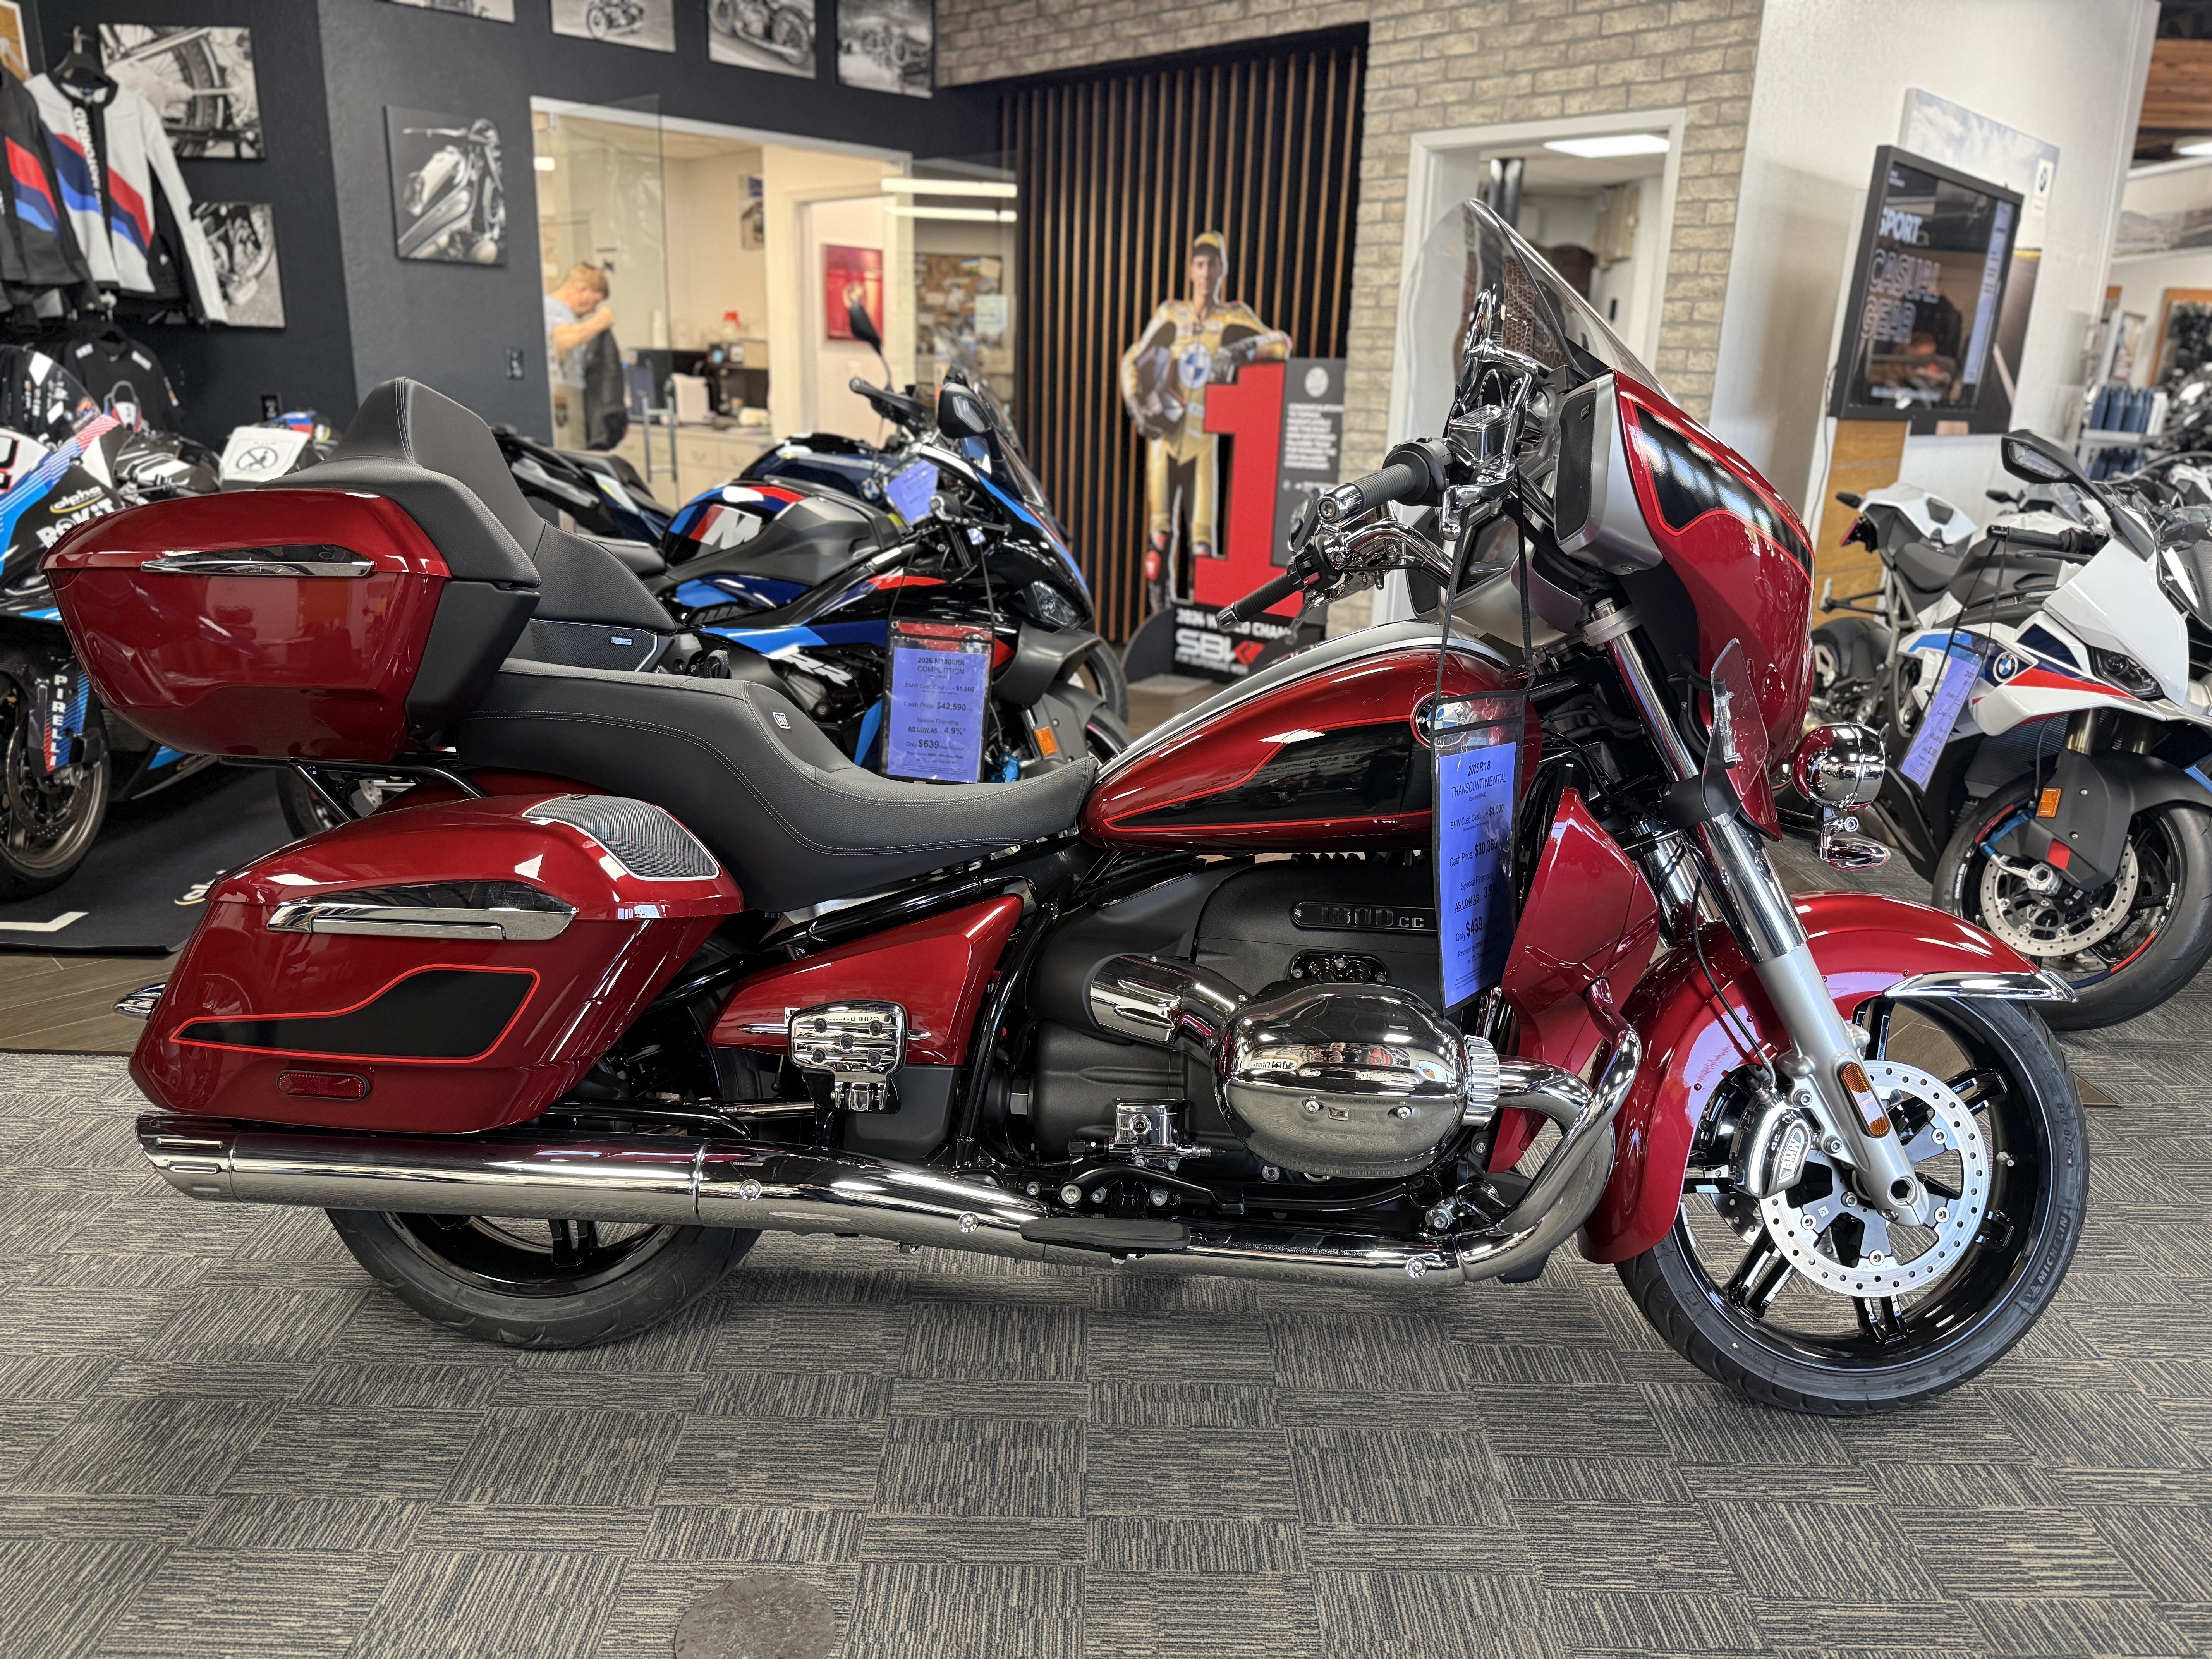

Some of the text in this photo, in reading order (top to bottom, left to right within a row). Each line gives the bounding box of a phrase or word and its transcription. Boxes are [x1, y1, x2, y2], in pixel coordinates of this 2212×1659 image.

[1869, 248, 1941, 304] CASUAL
[1860, 295, 1917, 344] GEAR
[53, 486, 101, 510] alpha
[917, 666, 964, 674] COMPETITION
[937, 702, 966, 711] $42,590
[49, 675, 68, 766] PIRELLI
[918, 739, 939, 749] $639
[1468, 760, 1491, 776] 2025 R18
[1451, 773, 1506, 798] TRANSCONTINENTAL
[1450, 817, 1461, 830] BMW
[1450, 855, 1461, 867] Cash
[1461, 878, 1475, 891] Special
[1455, 901, 1462, 911] AS
[1462, 896, 1472, 907] LOW
[1319, 906, 1393, 926] 1800
[1456, 915, 1483, 942] Only $439
[1783, 1138, 1801, 1170] BMW
[2037, 1216, 2068, 1284] MICHELIN
[1676, 1290, 1694, 1314] TOURING
